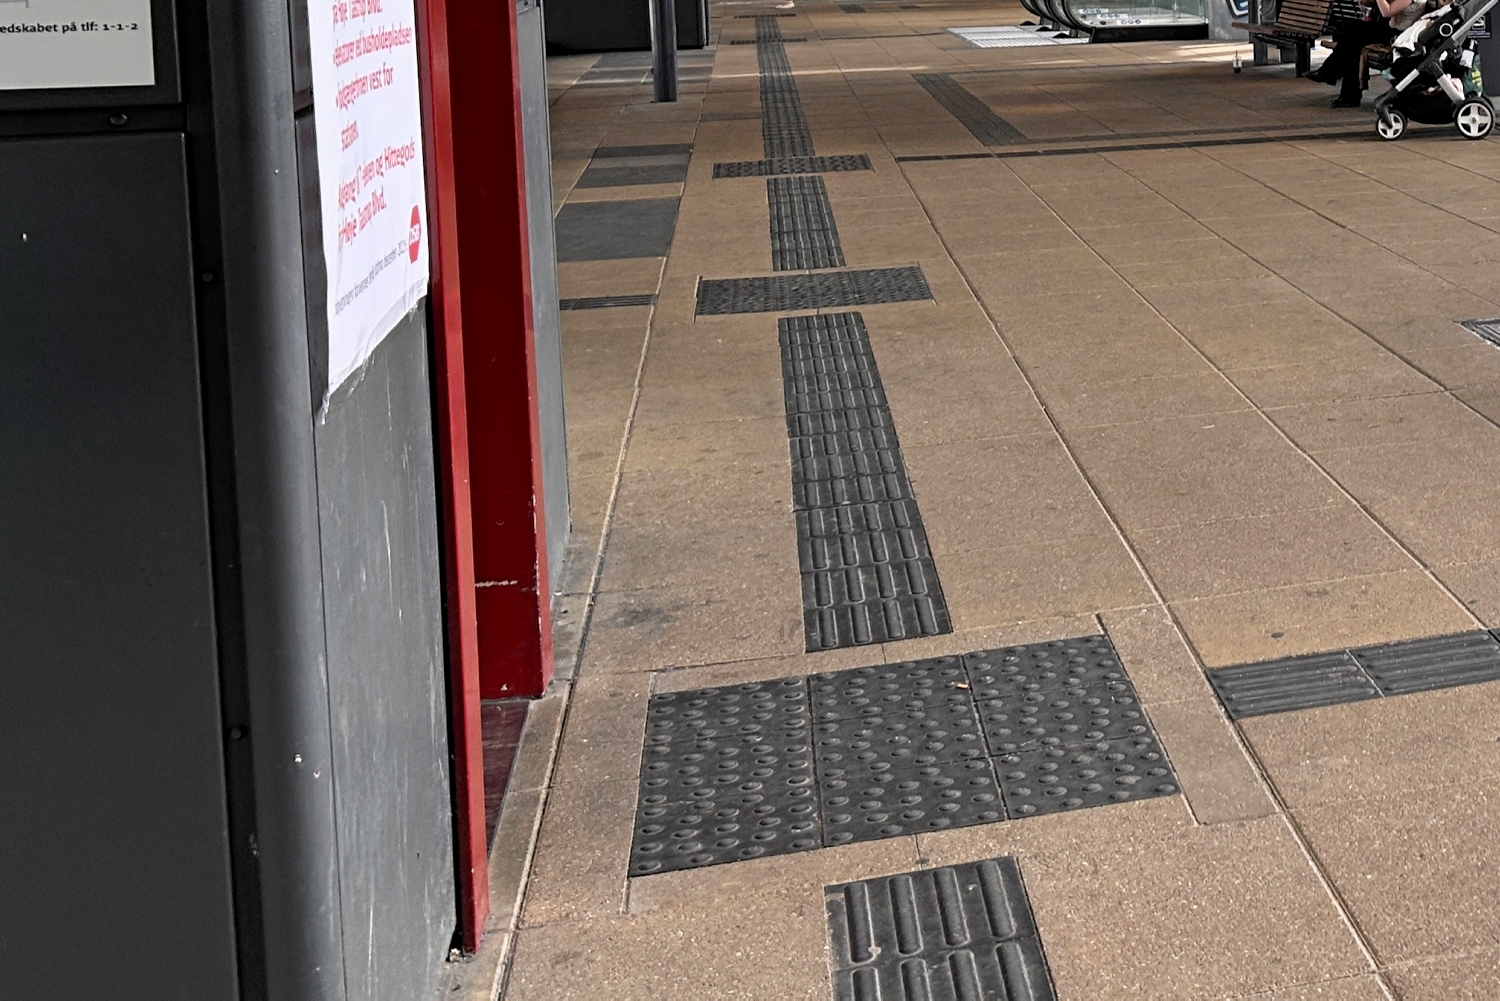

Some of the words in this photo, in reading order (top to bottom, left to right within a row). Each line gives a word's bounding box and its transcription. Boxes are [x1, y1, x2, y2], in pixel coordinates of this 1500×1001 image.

[62, 22, 77, 34] på
[81, 21, 98, 31] tlf:
[102, 22, 138, 31] 1-1-2
[383, 62, 394, 87] for
